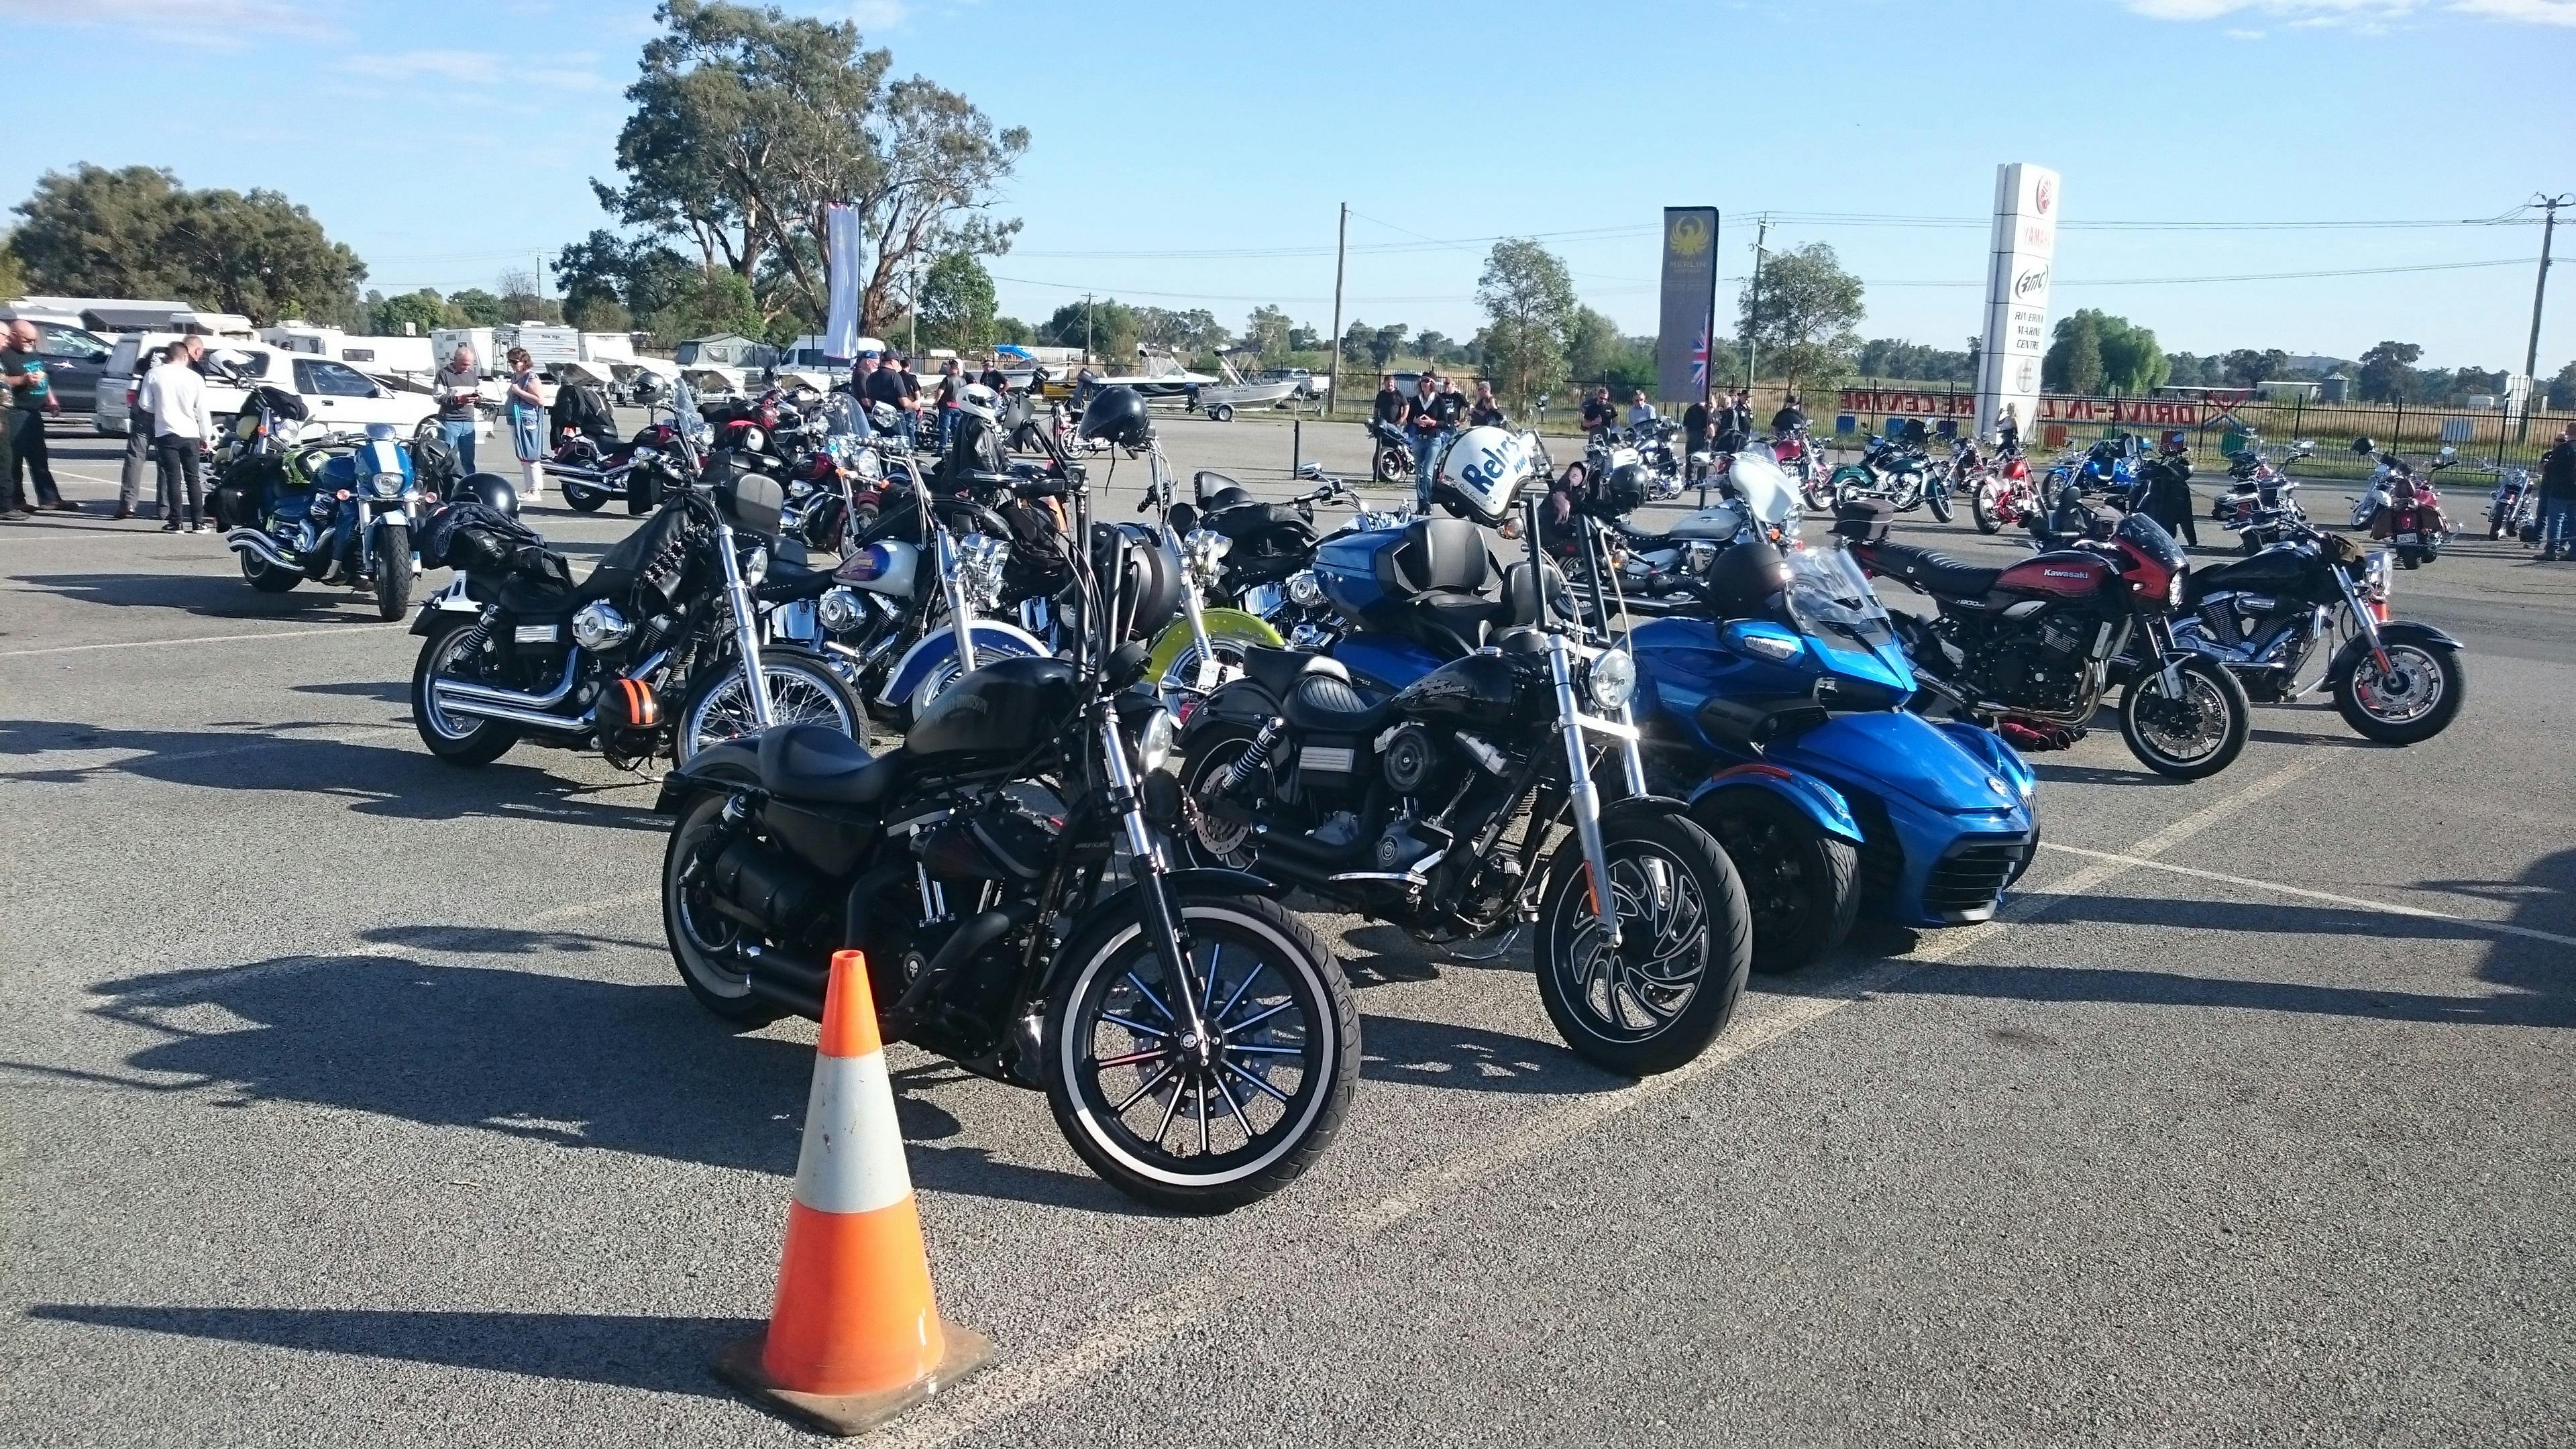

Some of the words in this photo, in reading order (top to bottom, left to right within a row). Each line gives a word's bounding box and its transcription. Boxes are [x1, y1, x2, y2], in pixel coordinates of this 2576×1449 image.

[1668, 261, 1706, 269] MERLIN
[2015, 311, 2043, 323] RIVERINA
[2018, 325, 2041, 337] MARINE
[2017, 339, 2039, 350] CENTRE
[2043, 569, 2088, 579] Kawasaki
